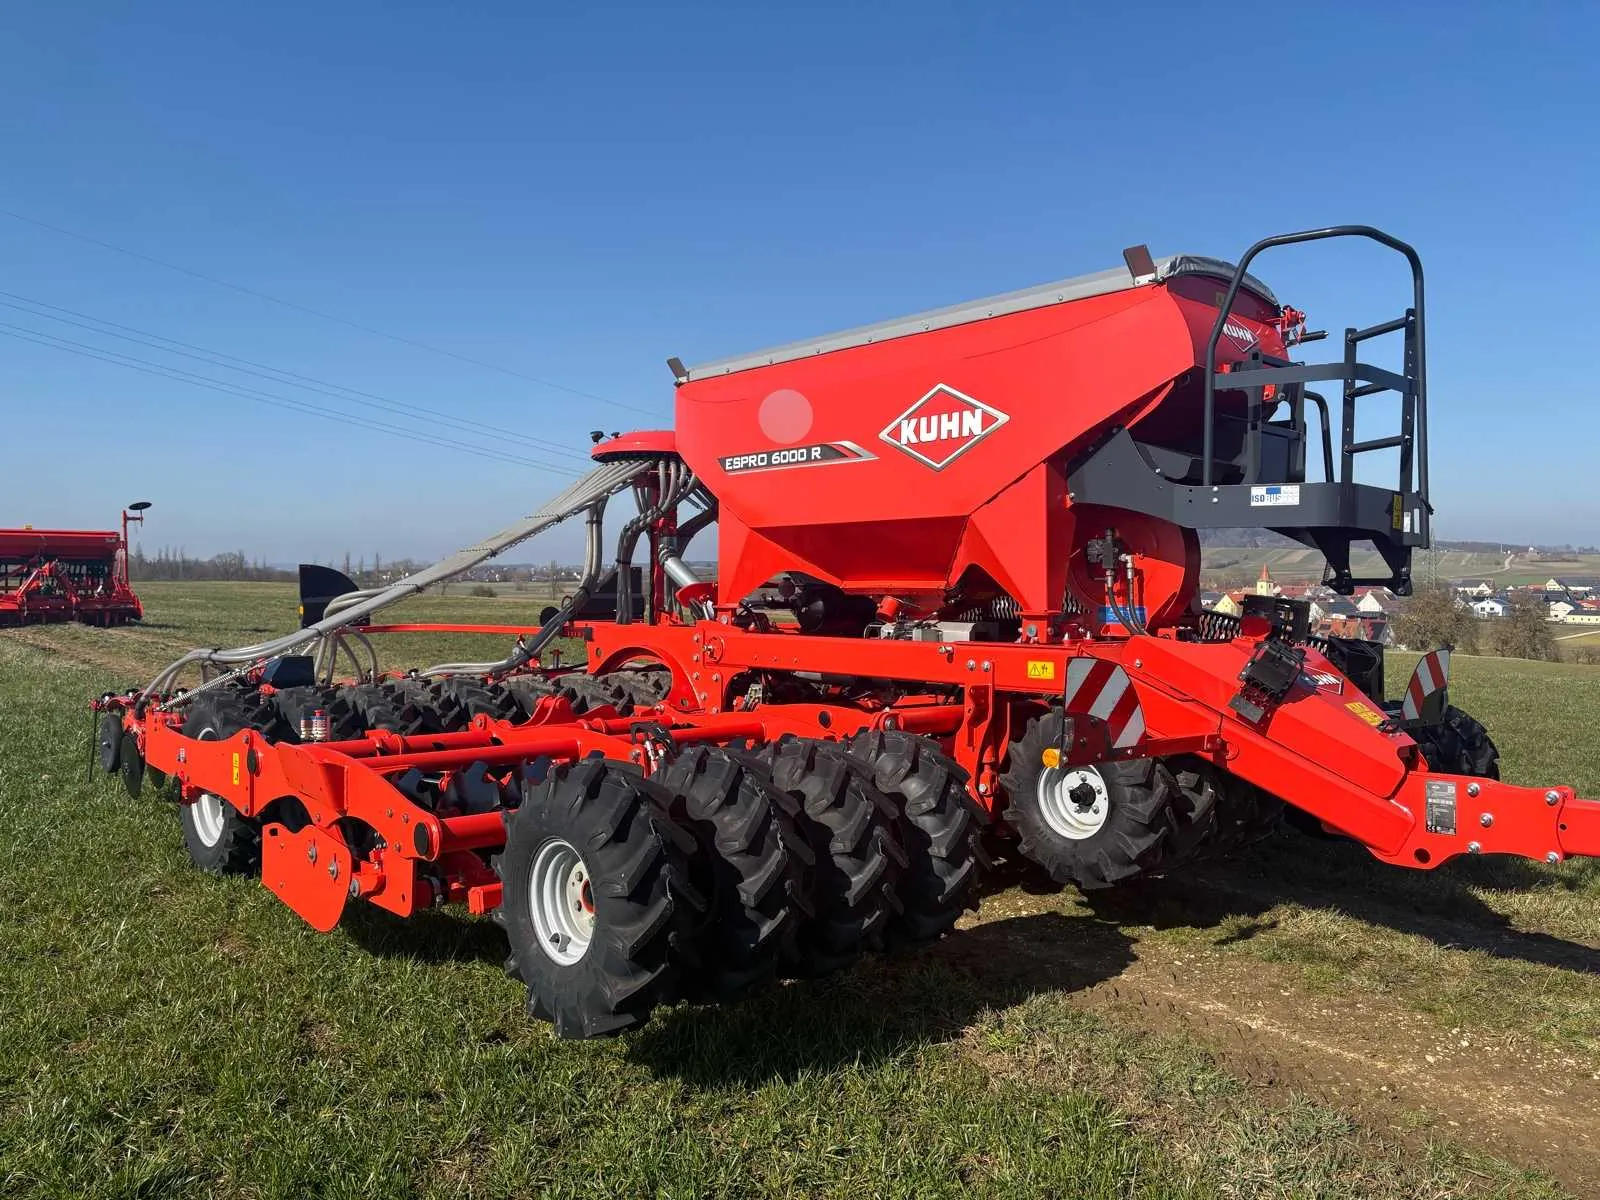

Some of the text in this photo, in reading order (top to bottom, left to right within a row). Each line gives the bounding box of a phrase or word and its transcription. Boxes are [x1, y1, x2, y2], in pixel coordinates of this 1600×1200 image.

[900, 409, 983, 444] KUHN
[725, 446, 821, 471] ESPRO 6000 R
